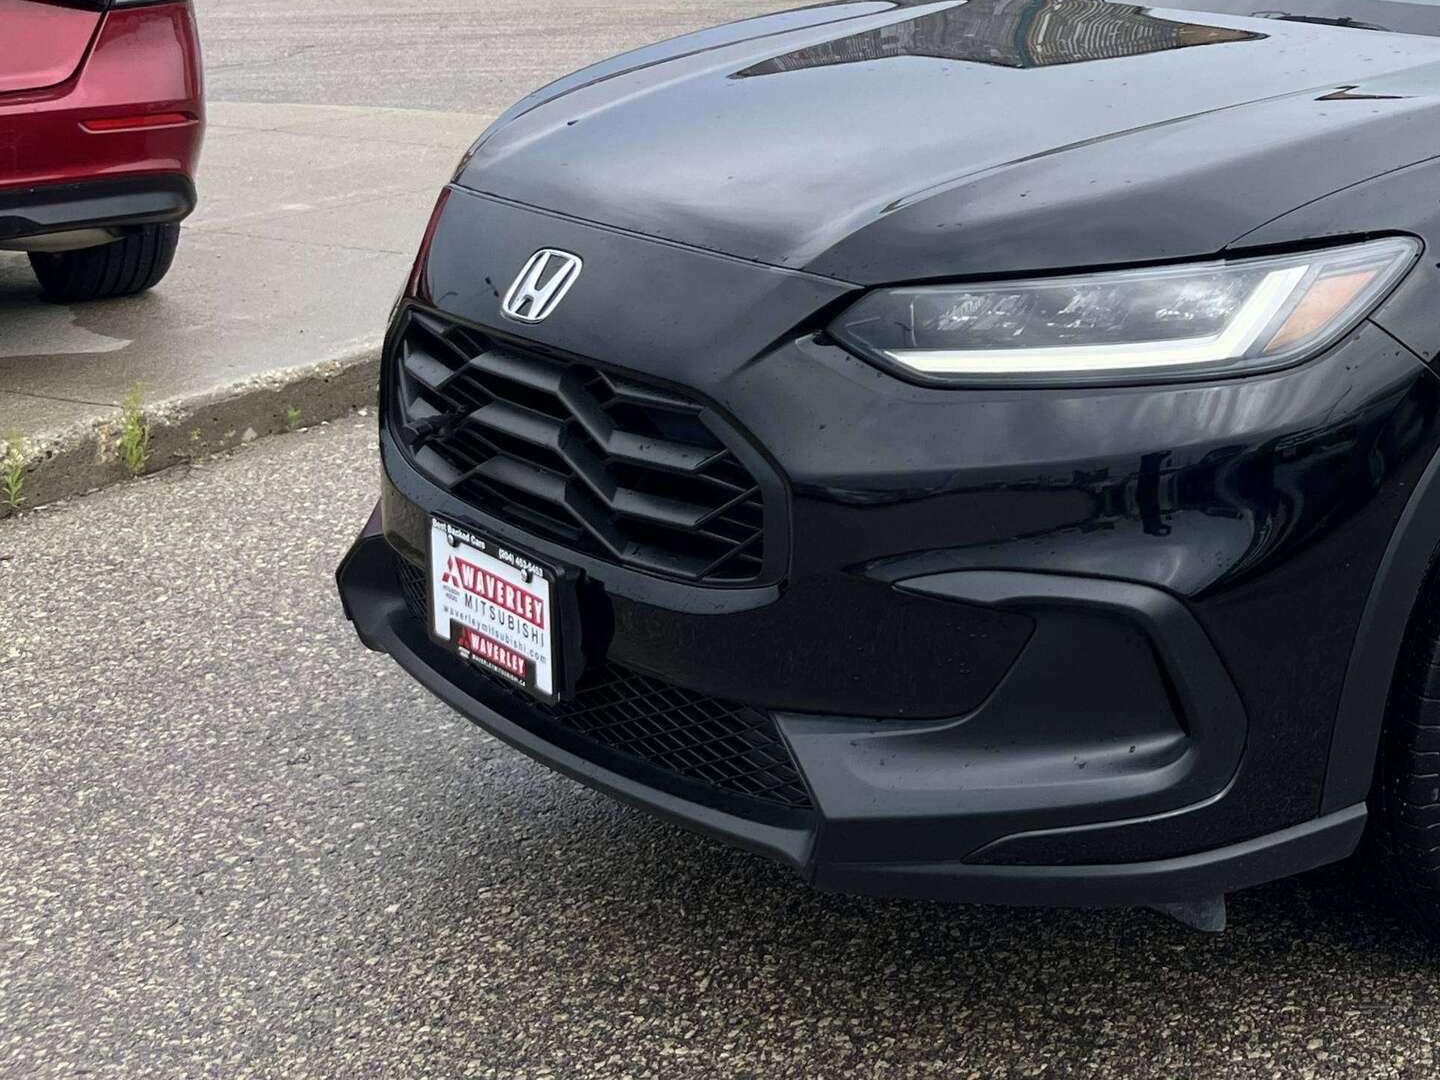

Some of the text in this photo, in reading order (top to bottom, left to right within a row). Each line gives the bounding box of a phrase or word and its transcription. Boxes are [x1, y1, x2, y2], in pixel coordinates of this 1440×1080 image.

[460, 560, 544, 626] WAVERLEY
[464, 592, 545, 648] MITSUBISHI
[471, 632, 525, 674] WAVERLEY
